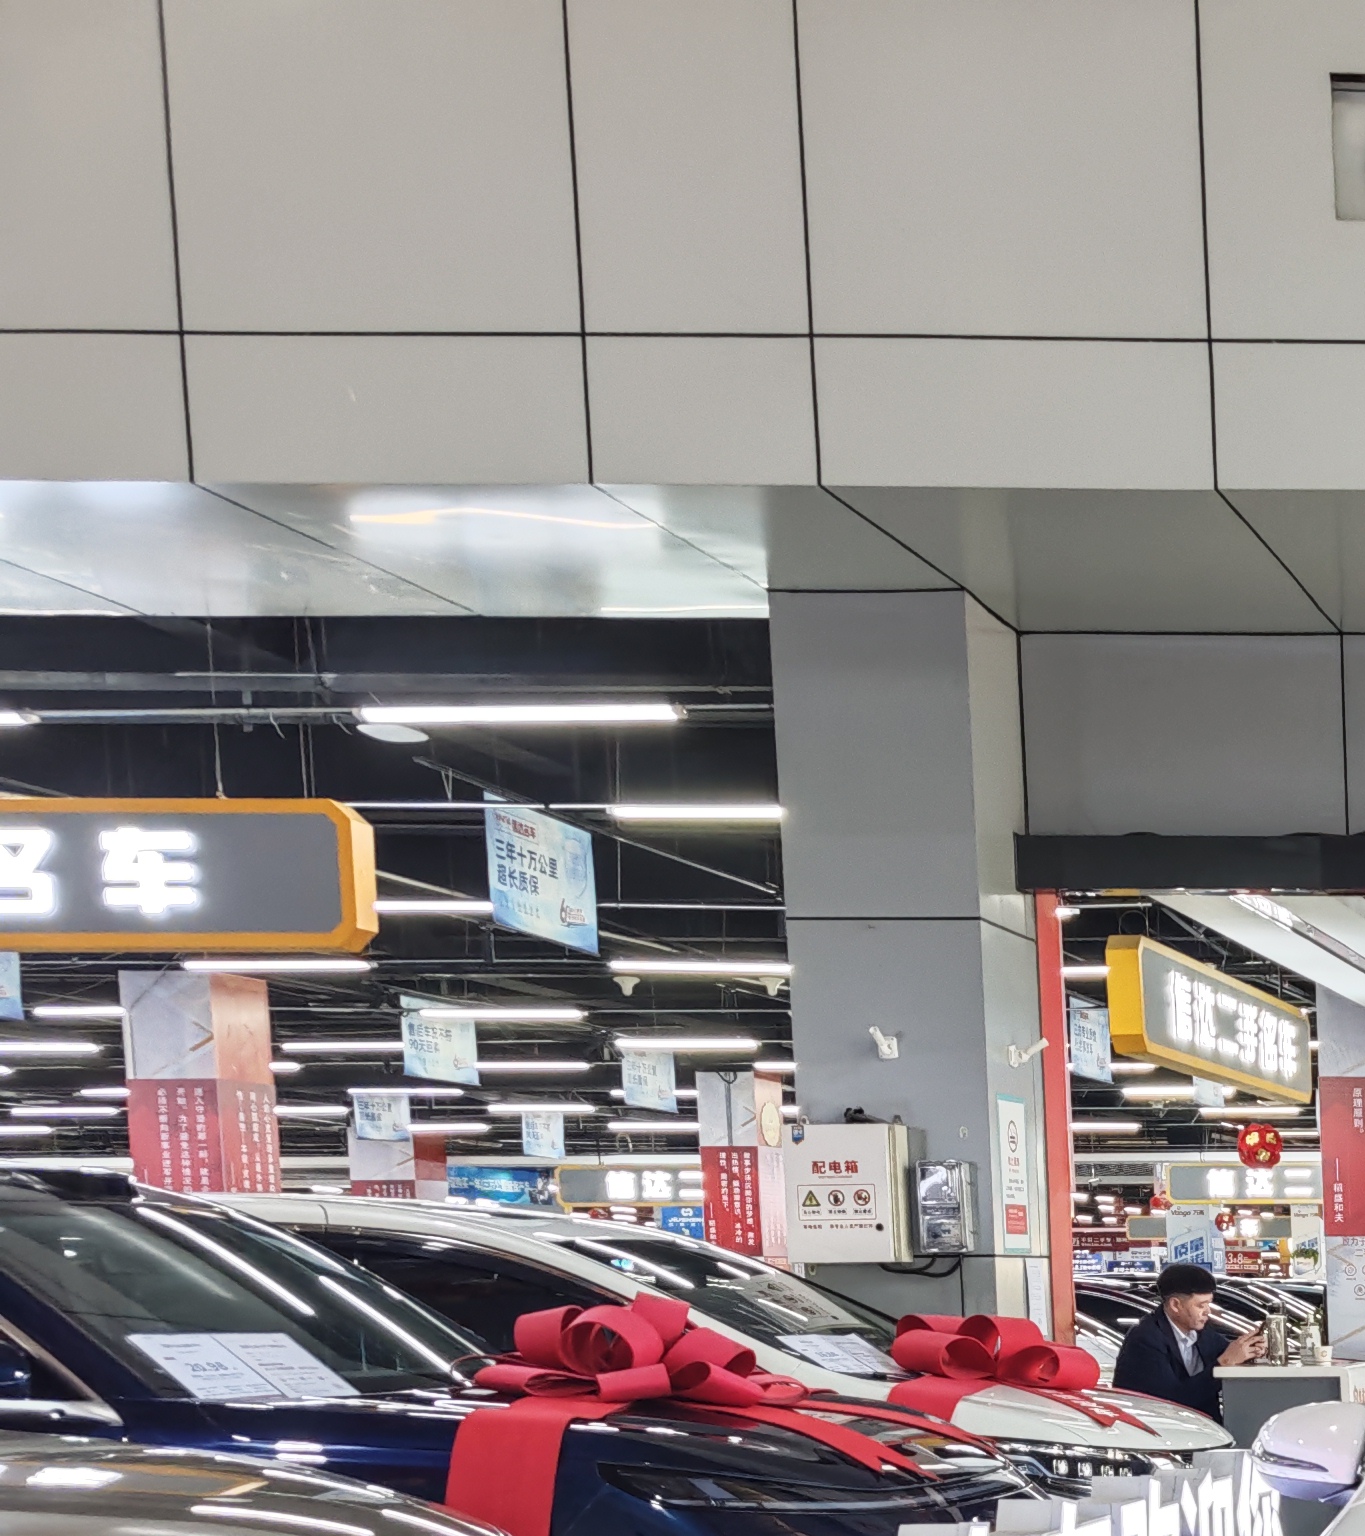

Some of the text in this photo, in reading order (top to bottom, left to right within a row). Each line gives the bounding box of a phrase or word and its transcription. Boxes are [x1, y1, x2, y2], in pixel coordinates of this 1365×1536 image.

[495, 838, 559, 880] 三年十万公里
[497, 863, 541, 897] 超长质保
[811, 1160, 859, 1174] 配电箱
